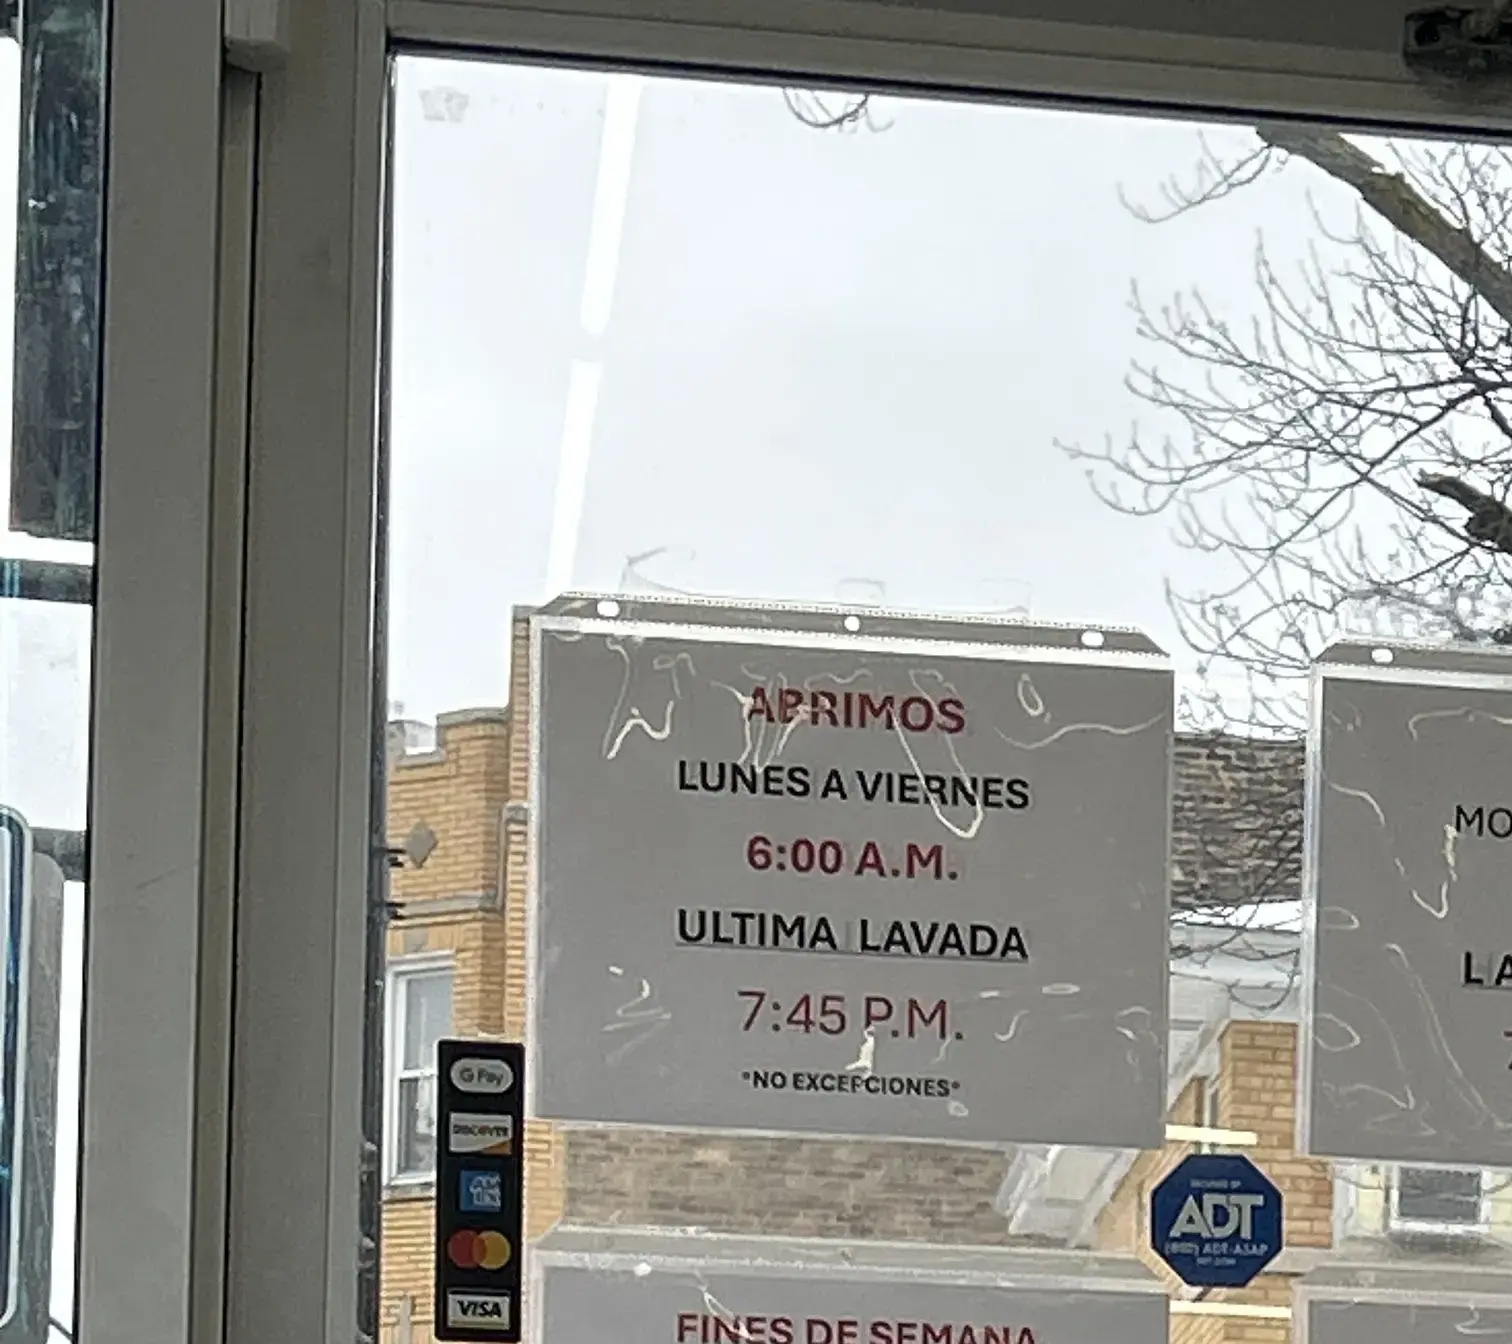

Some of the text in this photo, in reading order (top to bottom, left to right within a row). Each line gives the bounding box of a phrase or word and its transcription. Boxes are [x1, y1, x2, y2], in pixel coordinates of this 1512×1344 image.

[747, 685, 966, 733] ABRIMOS
[678, 761, 1030, 810] LUNES A VIERNES
[746, 836, 958, 881] 6:00 A.M.
[678, 909, 1029, 960] ULTIMA LAVADA
[737, 992, 964, 1040] 7:45 P.M.
[1169, 1193, 1264, 1240] ADT
[458, 1300, 501, 1318] VISA
